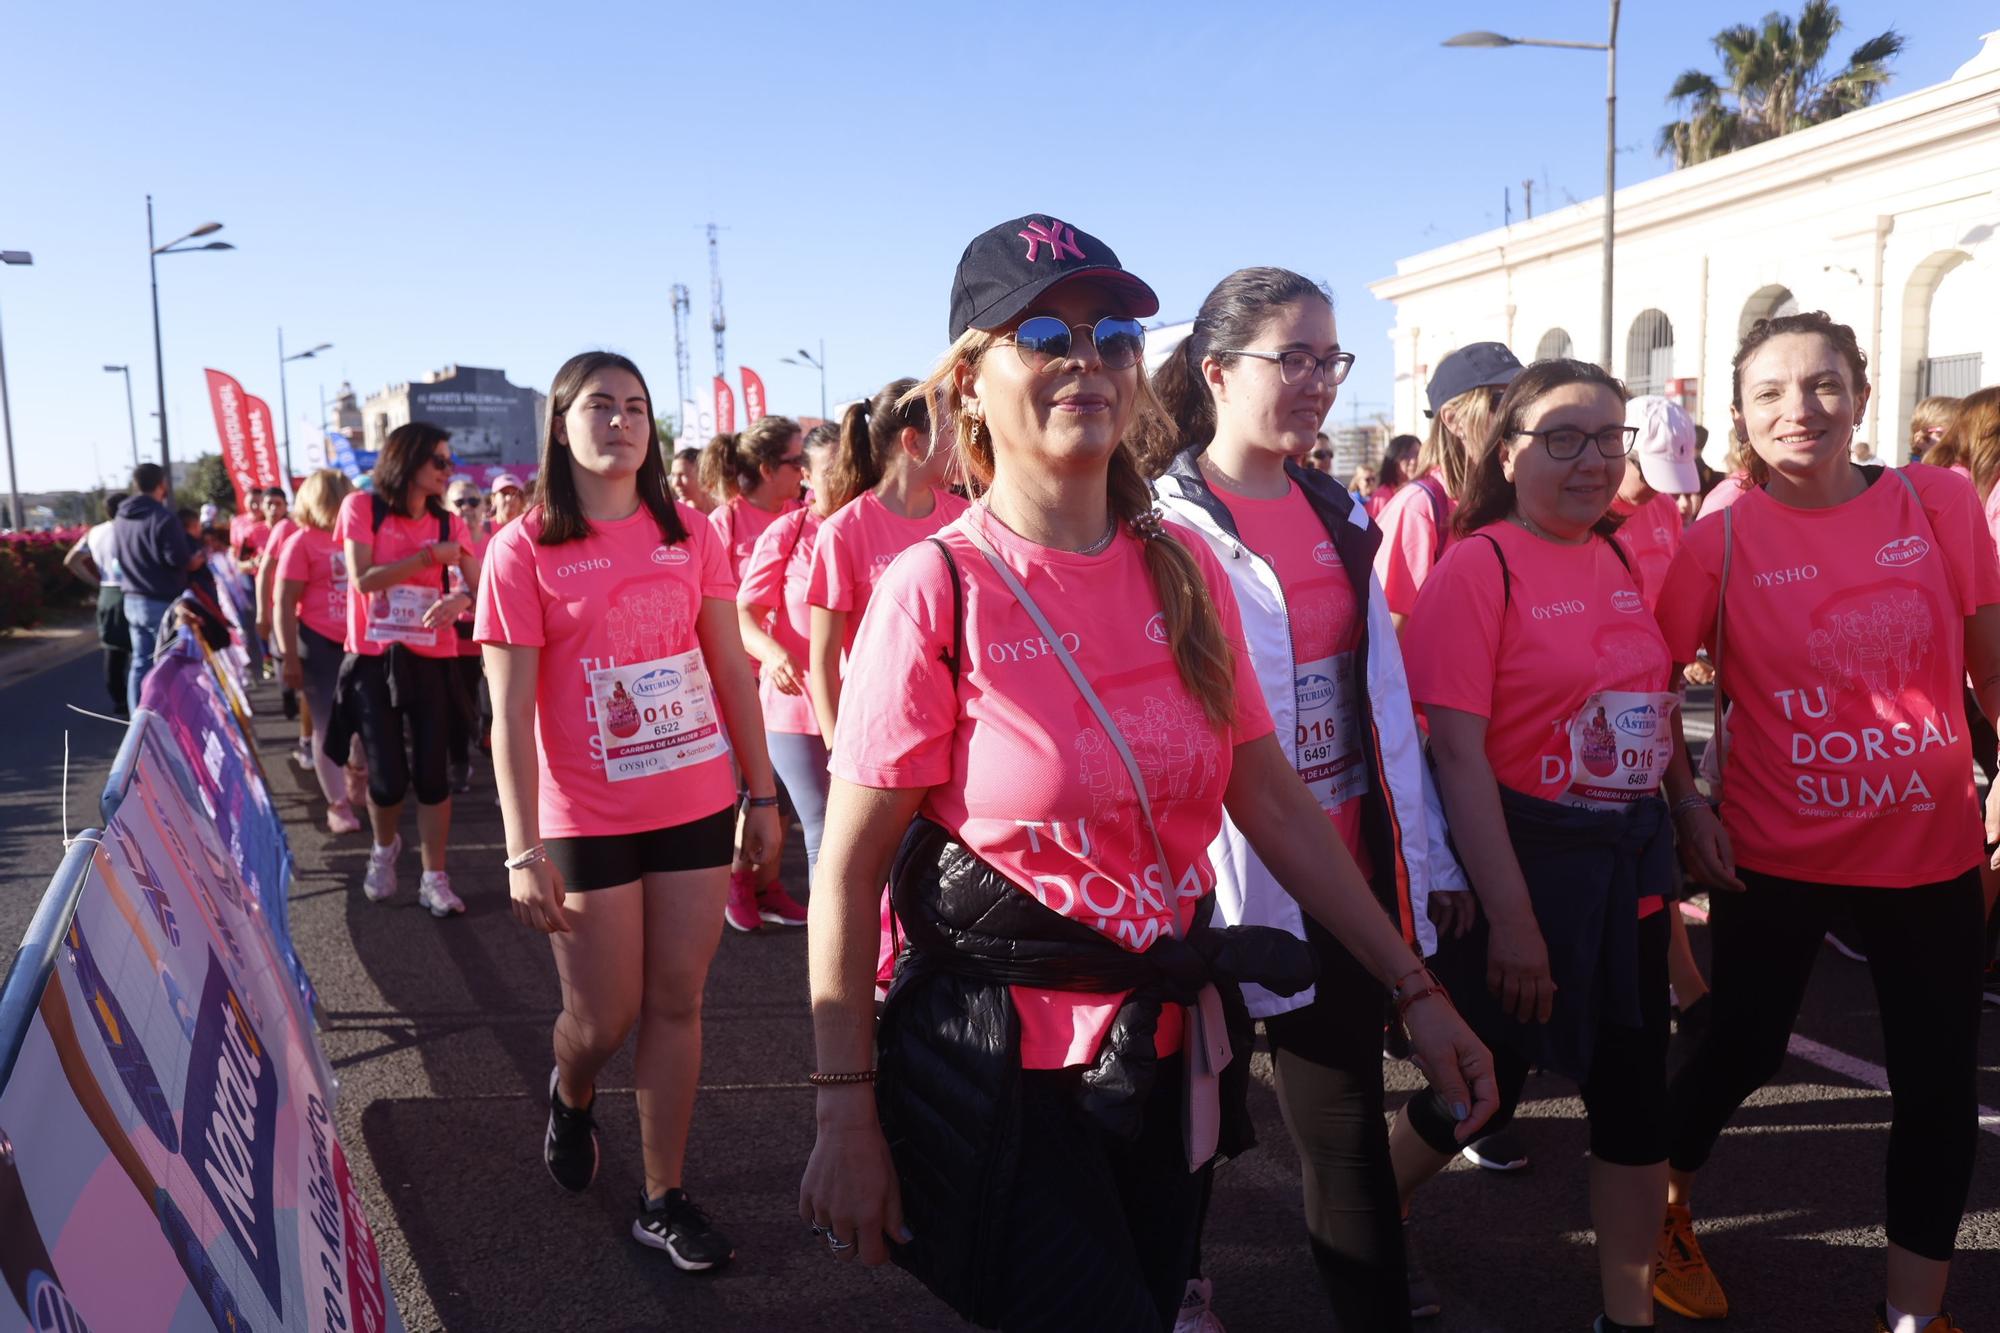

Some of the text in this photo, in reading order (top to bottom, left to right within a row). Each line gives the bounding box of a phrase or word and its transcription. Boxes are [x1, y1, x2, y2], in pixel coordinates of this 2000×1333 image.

[557, 557, 611, 578] OYSHO
[1532, 600, 1585, 620] OYSHO
[1297, 686, 1333, 703] STURIANA
[1774, 686, 1829, 720] TU
[643, 701, 684, 723] 016
[654, 721, 681, 736] 6522
[1296, 717, 1335, 746] 016
[1791, 712, 1959, 765] DORSAL
[620, 743, 656, 756] CARRERA
[656, 741, 666, 749] DE
[677, 732, 699, 744] MUJER
[1304, 744, 1331, 762] 6497
[619, 757, 658, 773] OYSHO
[1621, 748, 1654, 769] 016
[1627, 773, 1649, 785] 6499
[1796, 770, 1932, 808] SUMA
[1585, 788, 1621, 800] CARRERA
[1015, 816, 1091, 859] TU
